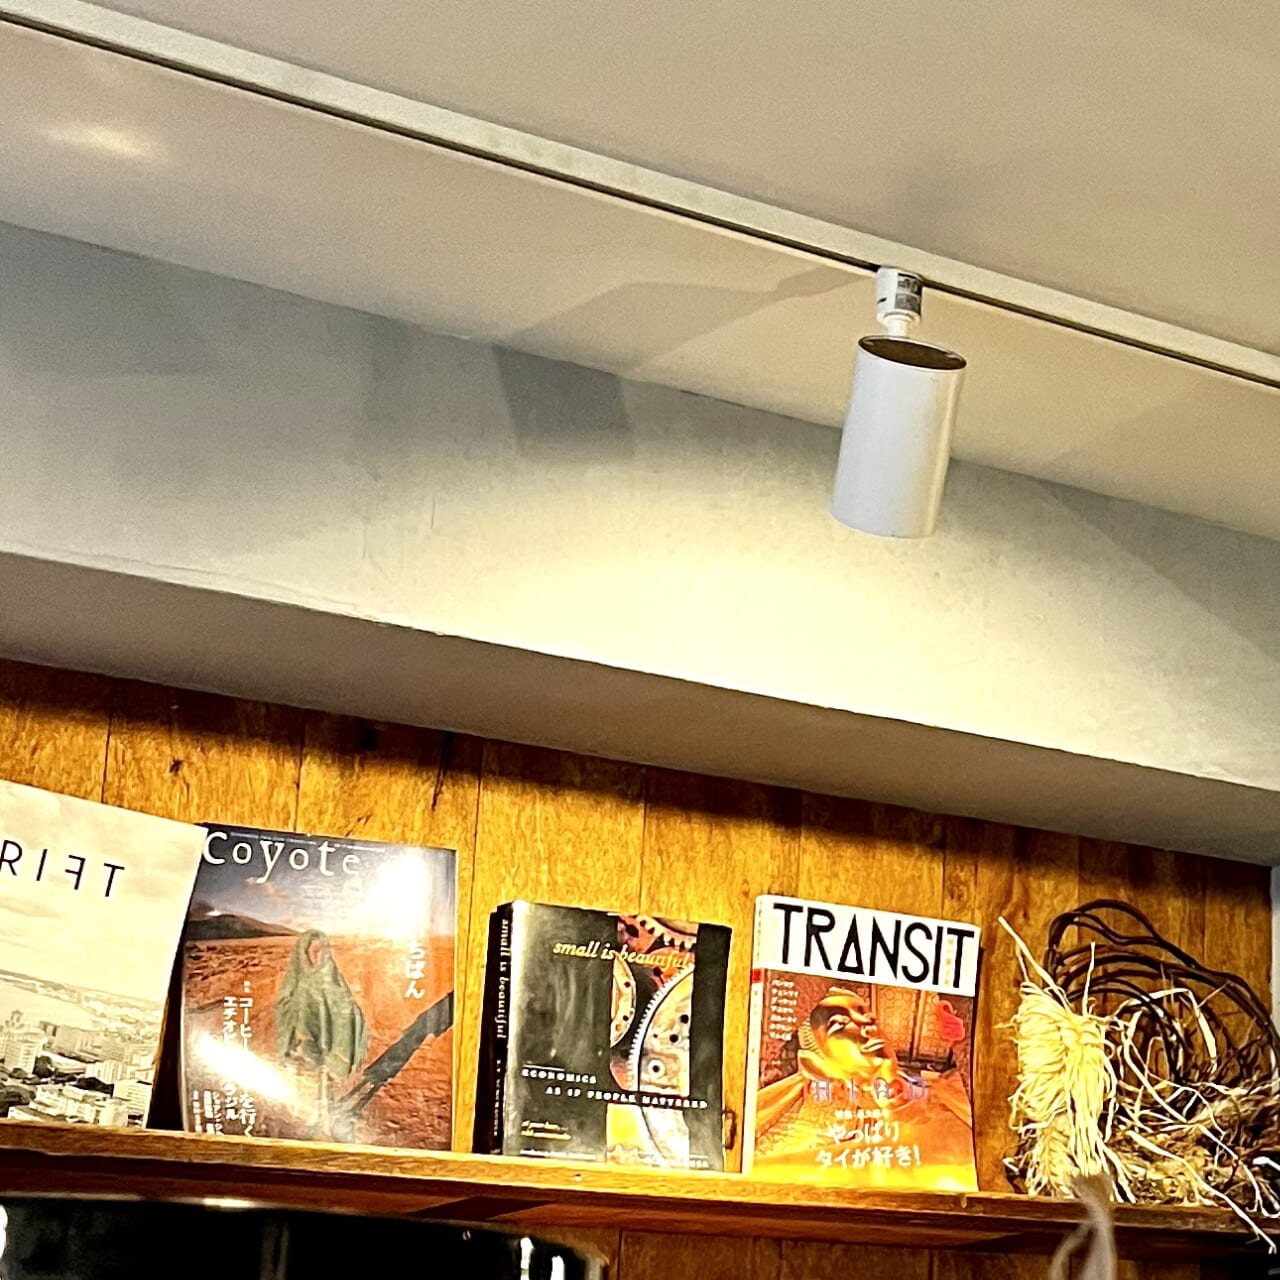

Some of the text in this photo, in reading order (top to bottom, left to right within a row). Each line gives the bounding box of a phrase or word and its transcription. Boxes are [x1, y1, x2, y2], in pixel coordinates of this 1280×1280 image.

[203, 831, 361, 884] Coyote
[553, 940, 690, 972] small is beautiful
[773, 903, 975, 989] TRANSIT
[494, 918, 510, 1039] small is beautiful
[521, 1068, 597, 1084] ECONOMICS
[545, 1086, 708, 1109] AS IF PEOPLE MATTERED
